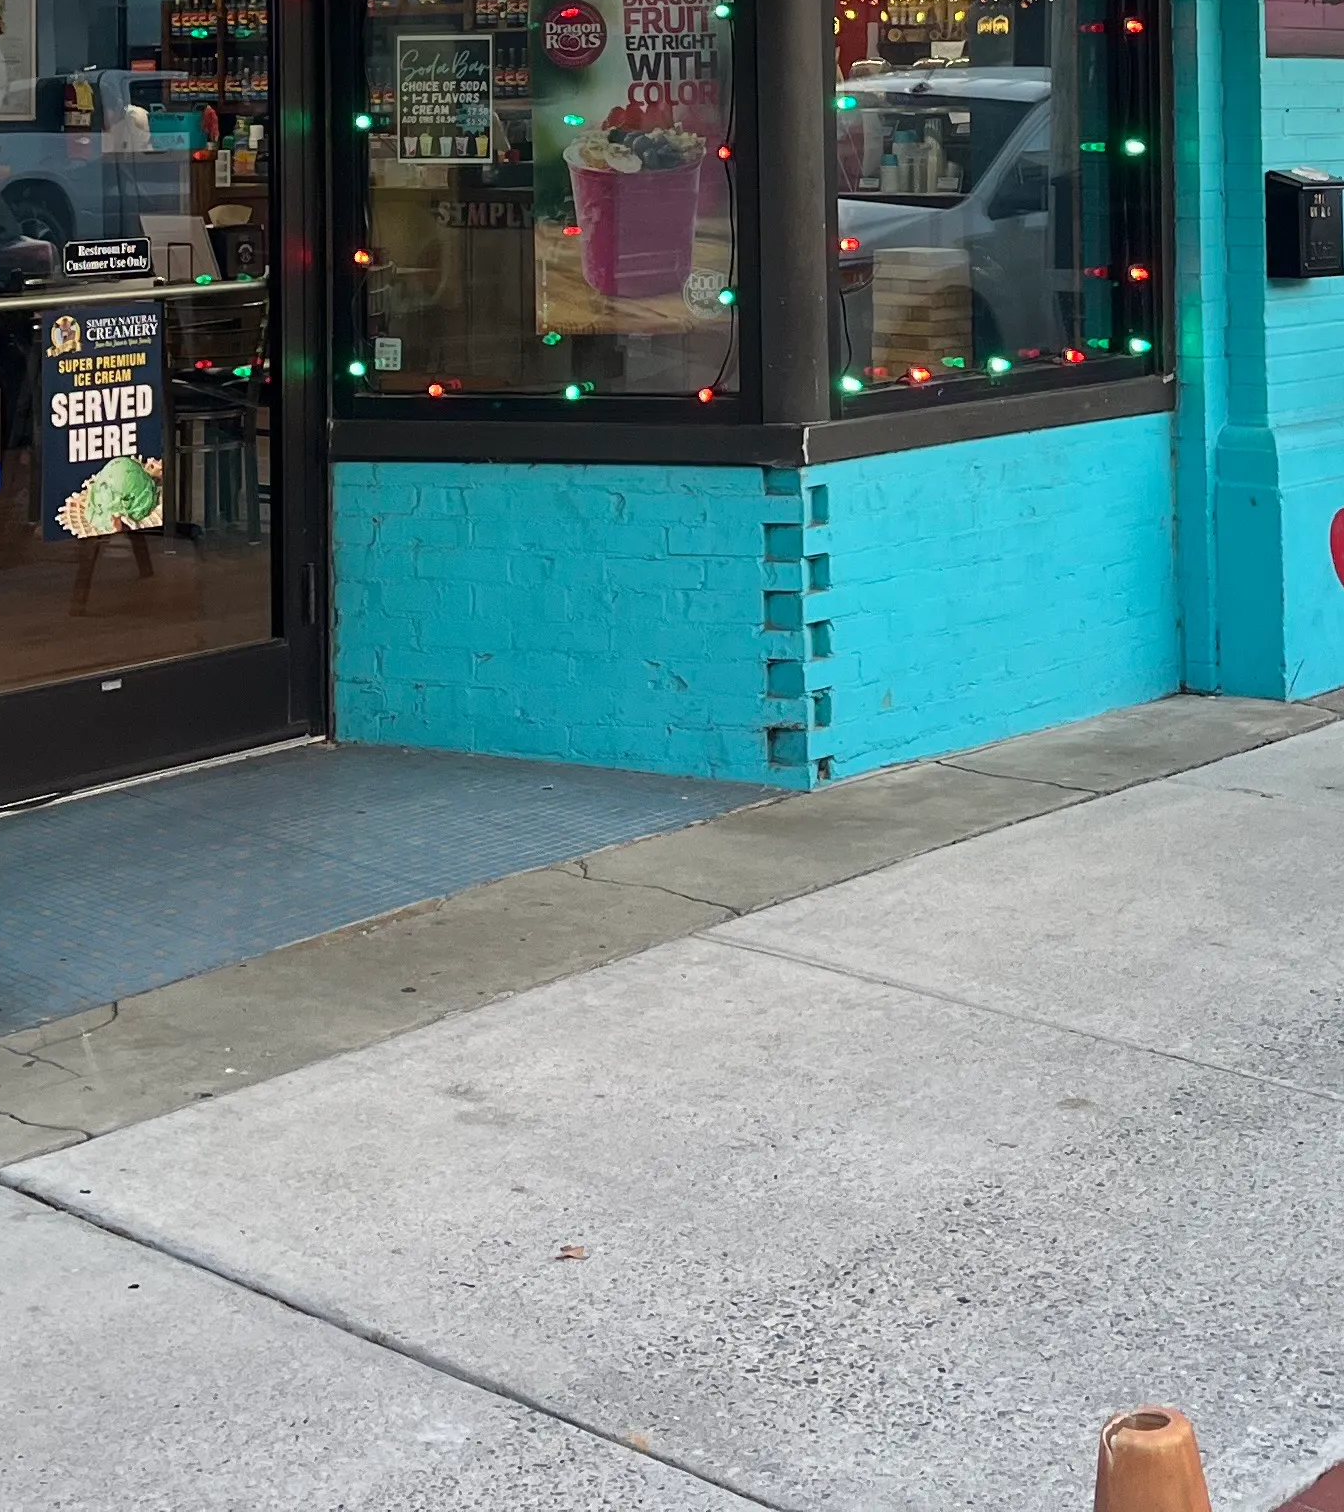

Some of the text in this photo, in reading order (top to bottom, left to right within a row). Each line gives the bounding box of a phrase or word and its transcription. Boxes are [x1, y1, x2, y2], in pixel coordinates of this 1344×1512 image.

[624, 6, 709, 34] FRUIT
[545, 23, 601, 37] Dragon
[626, 33, 716, 50] EAT RIGHT
[400, 49, 490, 82] Soda Bar
[626, 50, 718, 81] WITH
[401, 81, 488, 92] CHOICE OF SODA
[628, 80, 719, 106] COLOR
[431, 92, 480, 103] FLAVORS
[412, 104, 450, 115] CREAM
[78, 243, 137, 257] Restroom For
[66, 255, 147, 272] Customer Use Only
[86, 315, 158, 328] SIMPLY NATURAL
[86, 323, 158, 341] CREAMERY
[58, 352, 146, 373] SUPER PREMIUM
[74, 369, 131, 386] ICE CREAM
[51, 385, 153, 428] SERVED
[68, 422, 137, 463] HERE
